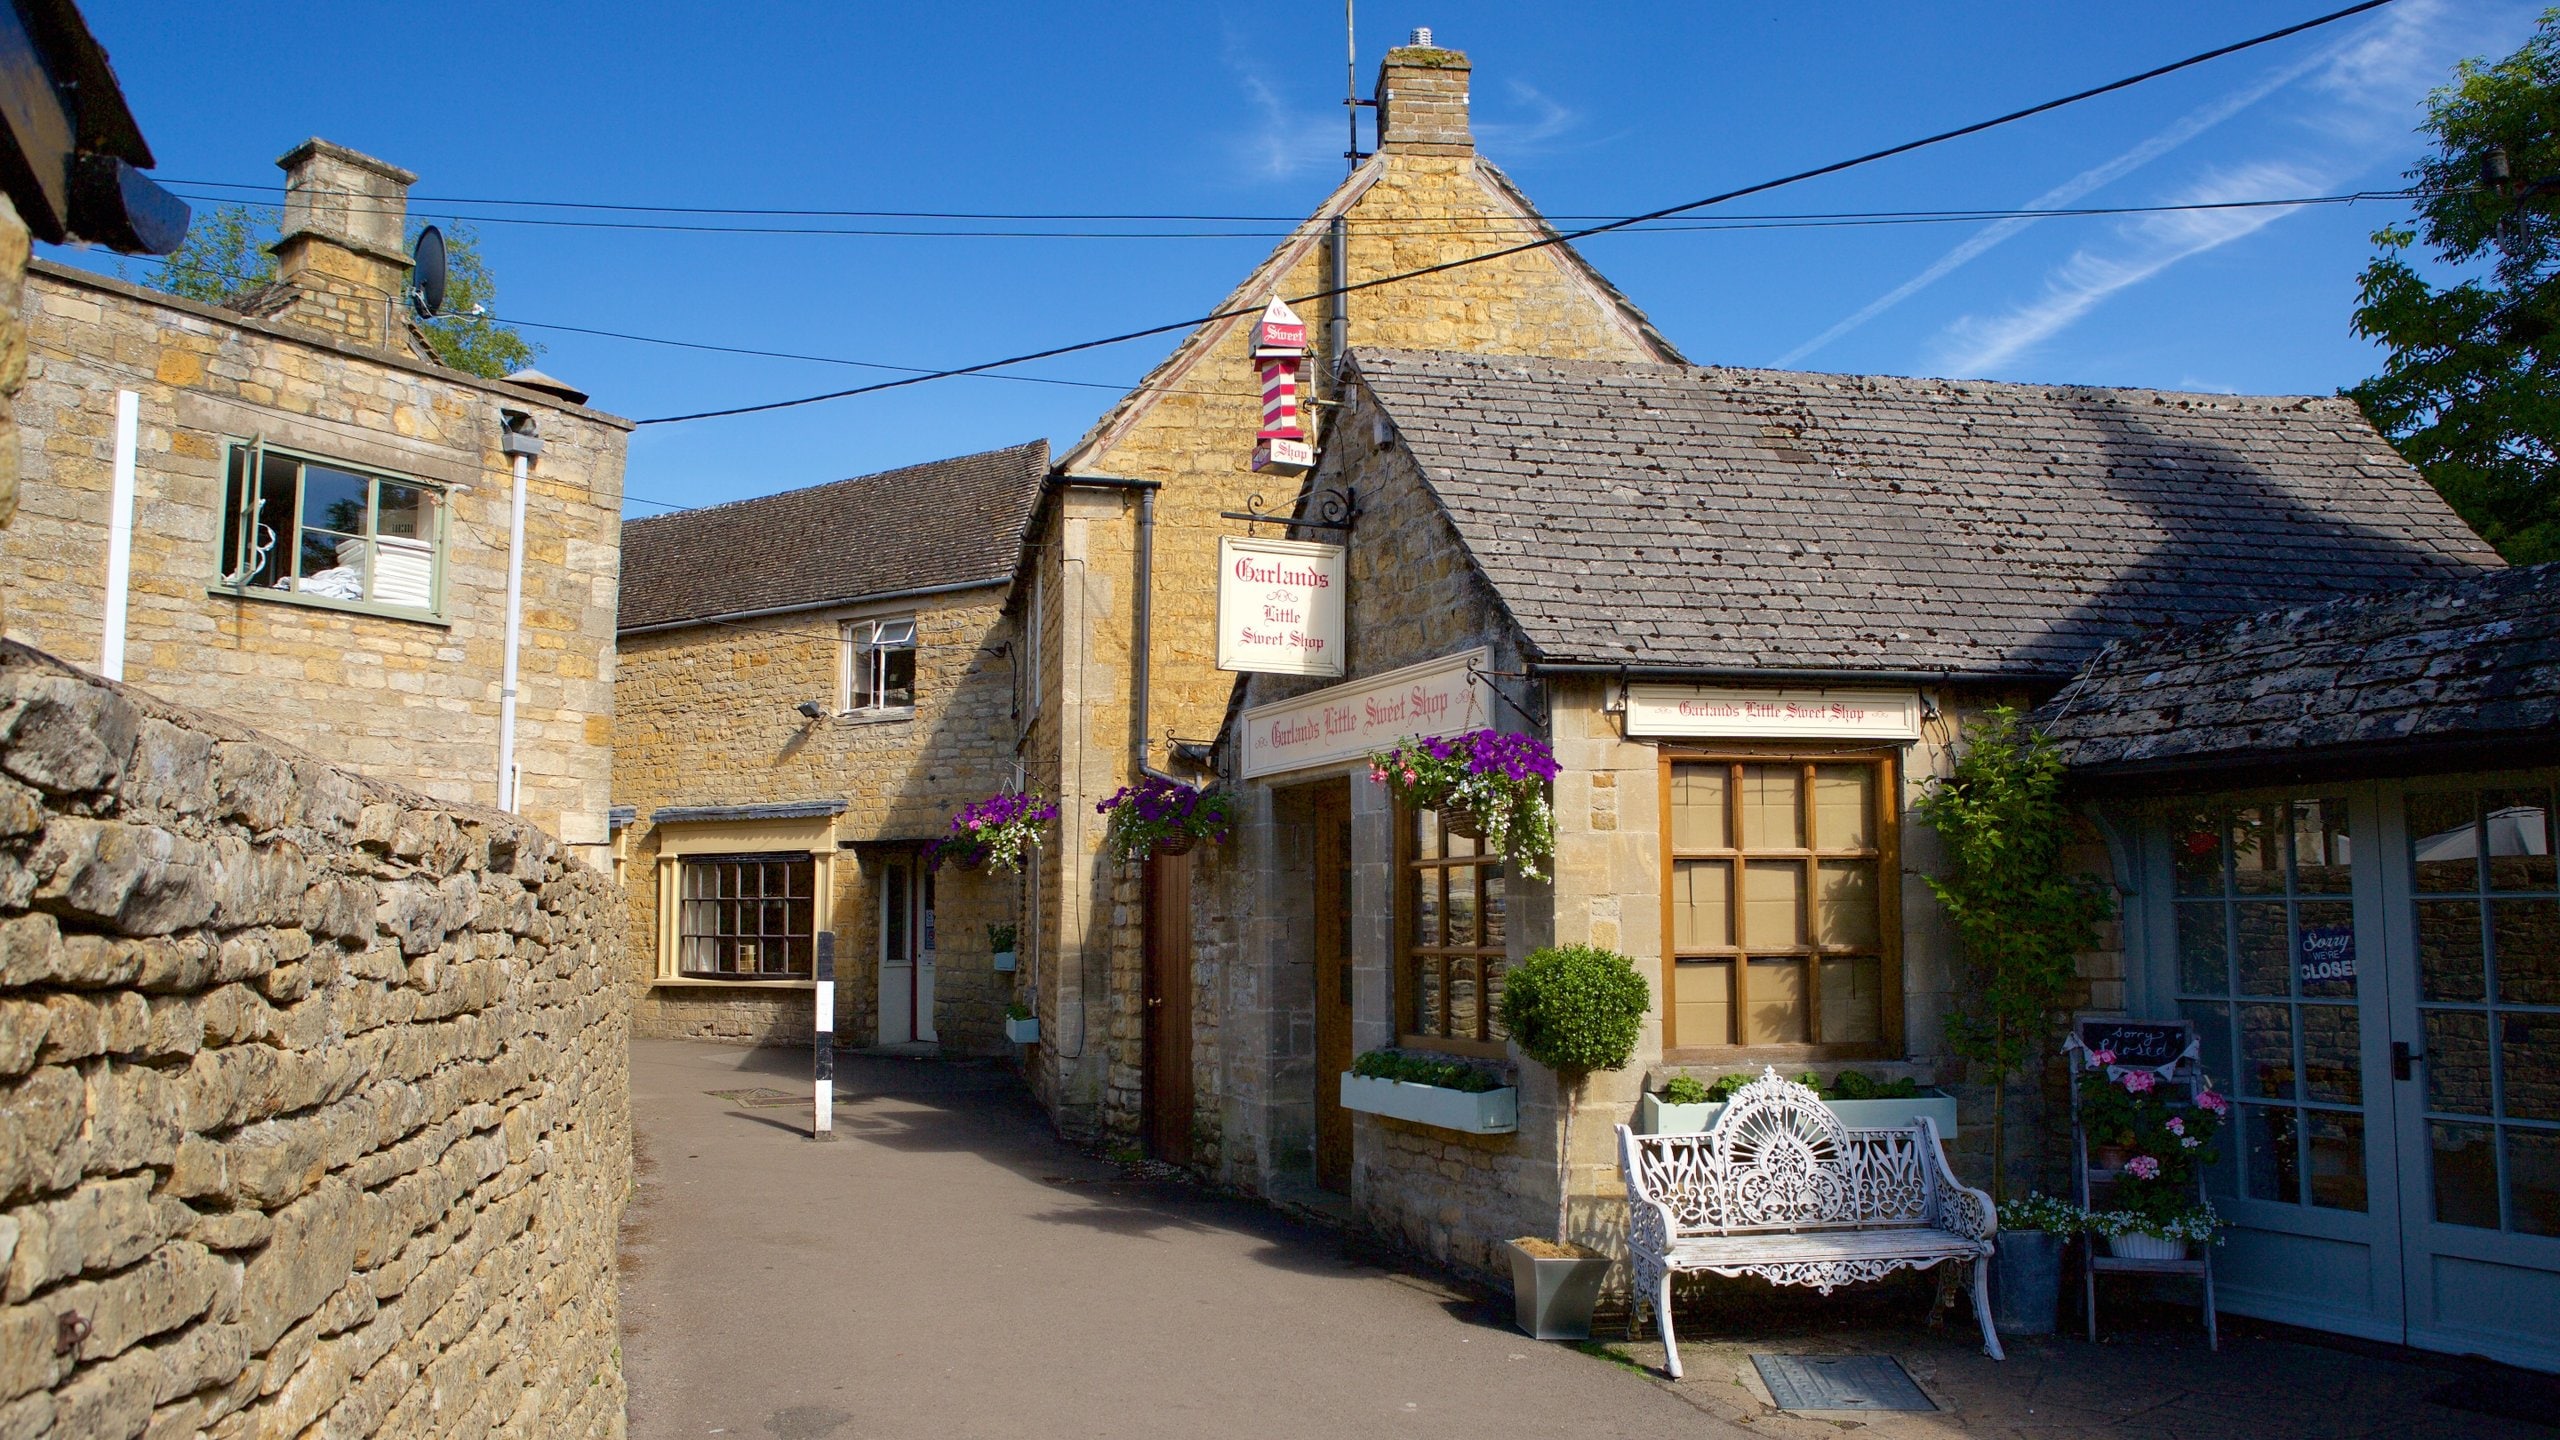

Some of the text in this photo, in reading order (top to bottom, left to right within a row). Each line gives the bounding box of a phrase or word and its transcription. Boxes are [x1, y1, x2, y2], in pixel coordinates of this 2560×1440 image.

[1264, 324, 1303, 342] Sweet
[1275, 441, 1307, 462] Shop
[1235, 556, 1329, 588] Garlands
[1263, 604, 1301, 627] Little
[1238, 627, 1324, 653] Sweet Shop
[1271, 685, 1449, 749] Garlands Little Sweet Shop
[1679, 700, 1864, 724] Garlands Little Sweet Shop
[2303, 932, 2350, 953] Sorry
[2312, 950, 2340, 960] WE'RE
[2301, 960, 2357, 980] CLOSE
